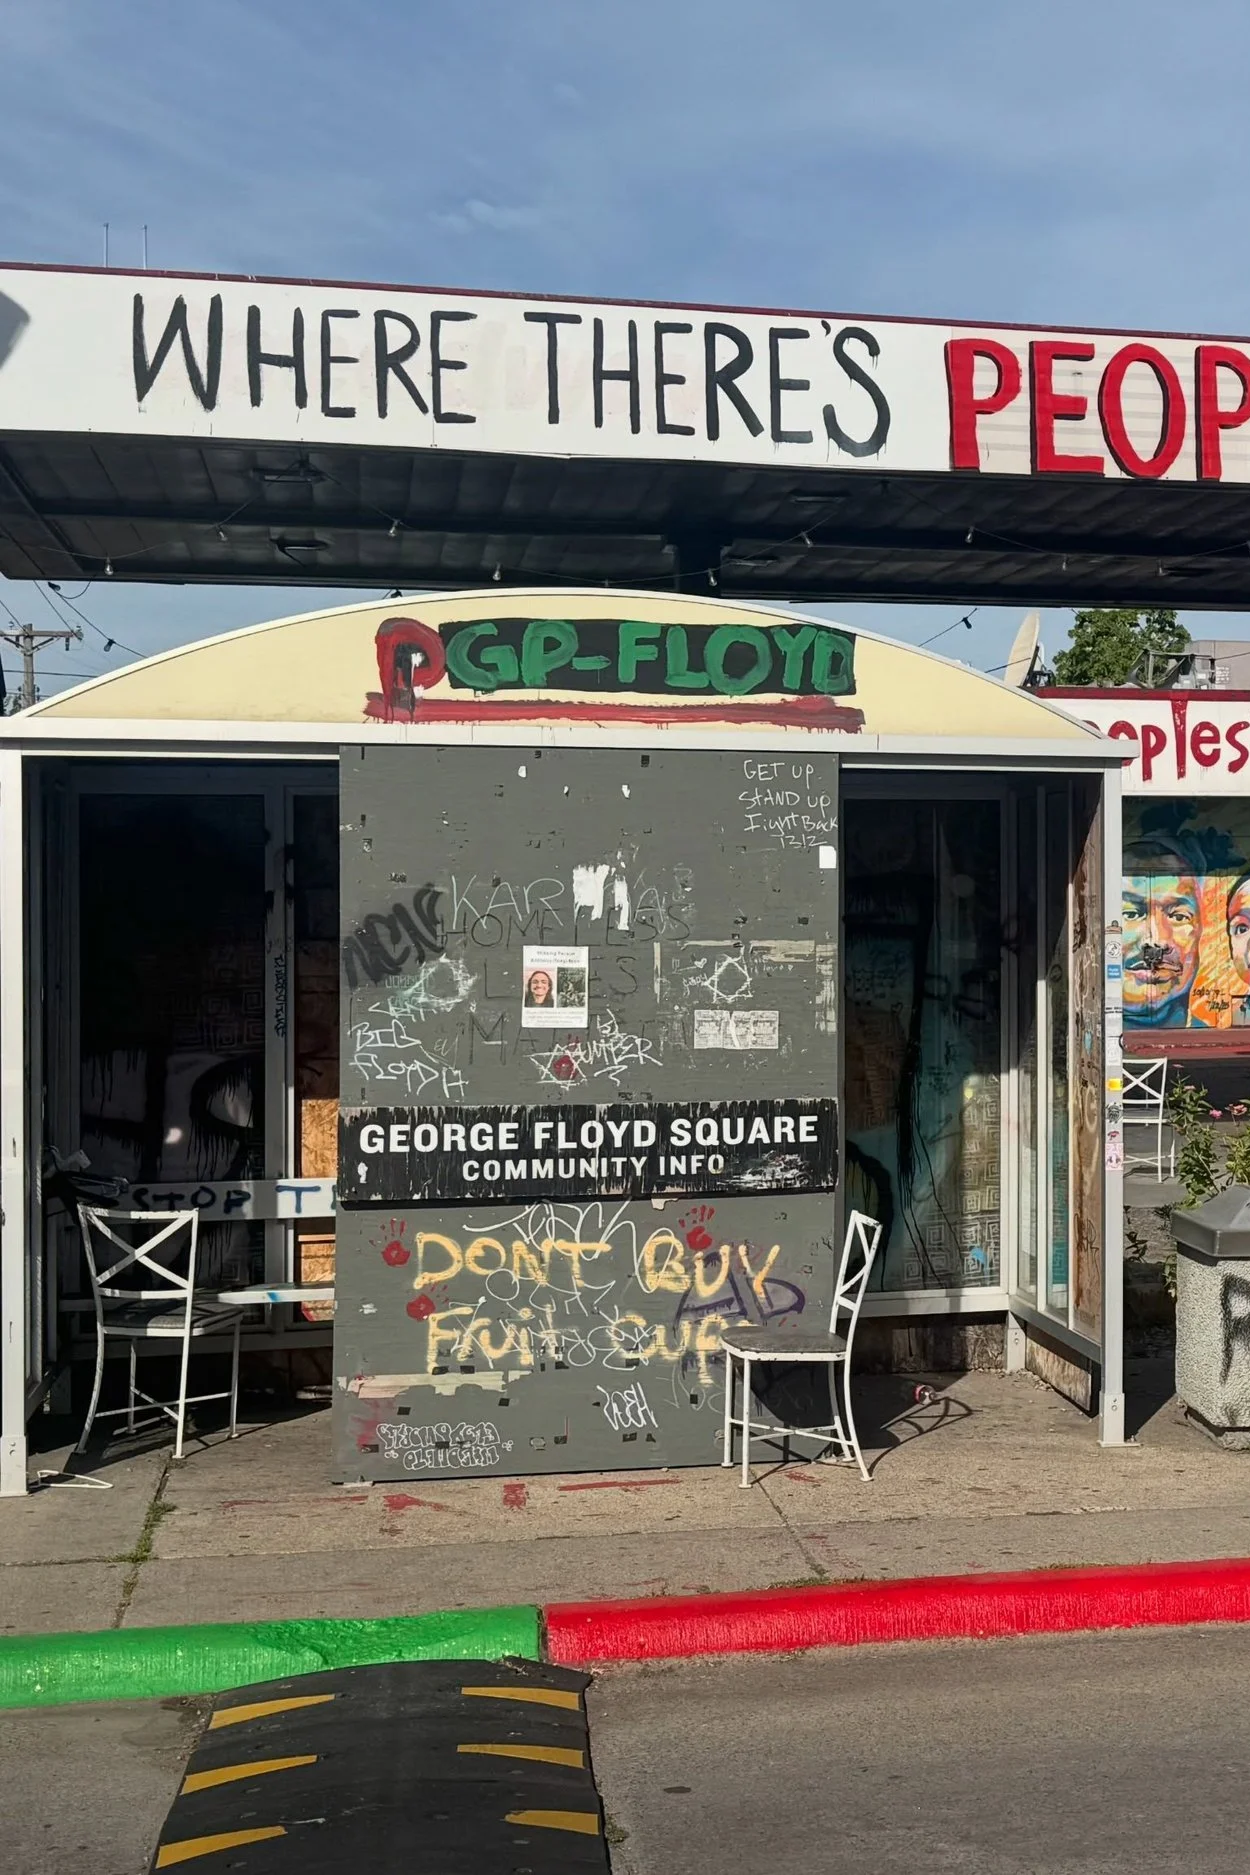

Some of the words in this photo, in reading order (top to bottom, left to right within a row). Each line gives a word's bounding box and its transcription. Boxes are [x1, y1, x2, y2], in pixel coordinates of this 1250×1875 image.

[133, 293, 478, 424] WHERE
[524, 310, 891, 458] THERE'S
[743, 759, 786, 781] GET
[359, 1121, 519, 1154] GEORGE
[533, 1119, 658, 1151] FLOYD
[669, 1115, 819, 1147] SQUARE
[462, 1156, 647, 1181] COMMUNITY
[659, 1154, 726, 1176] INFO
[132, 1186, 251, 1214] STOP
[643, 1234, 781, 1302] BUY
